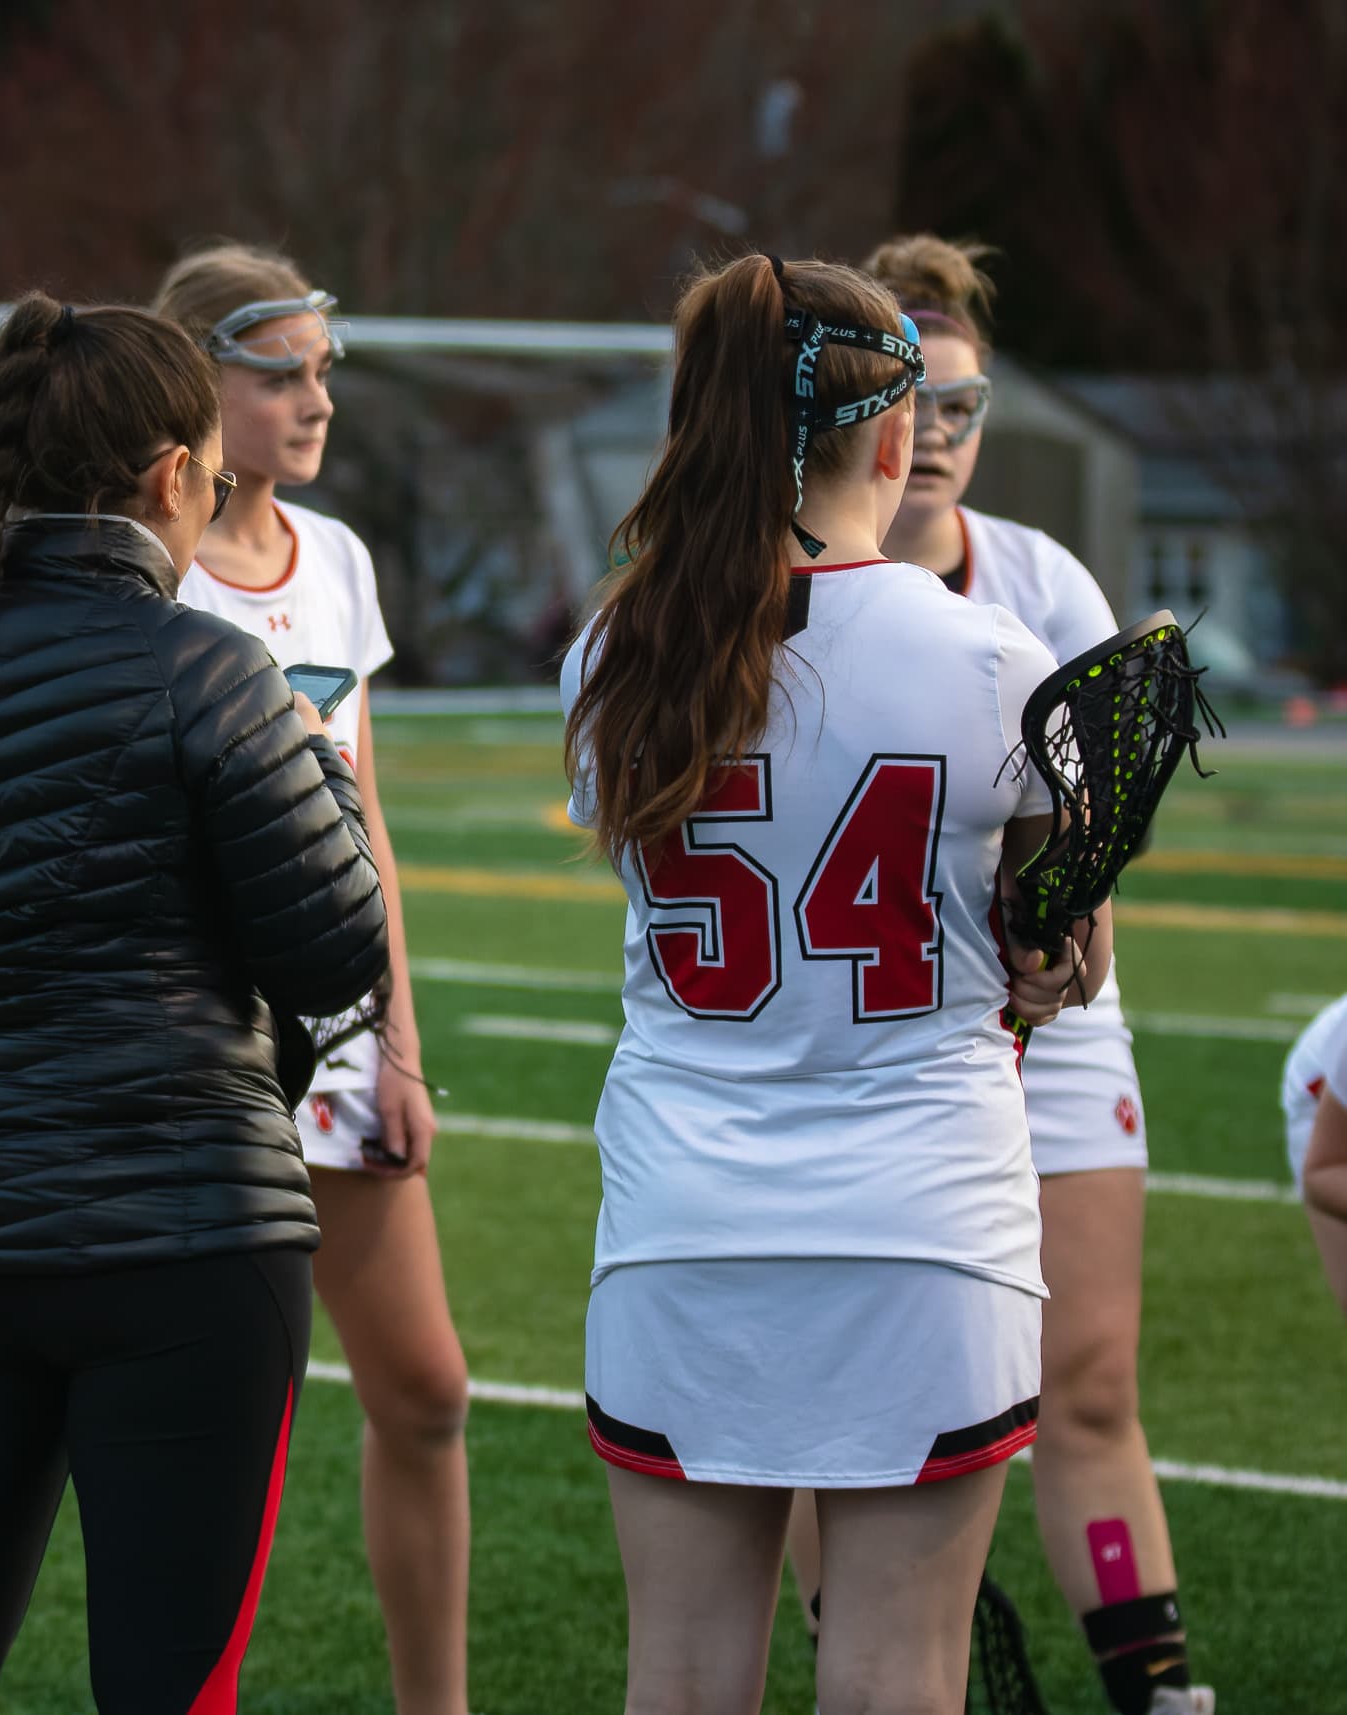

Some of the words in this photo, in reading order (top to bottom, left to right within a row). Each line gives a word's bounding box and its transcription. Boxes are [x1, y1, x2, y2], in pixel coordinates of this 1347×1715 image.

[823, 325, 858, 339] PLUS
[881, 332, 916, 364] STX
[795, 341, 822, 399] STX
[834, 389, 891, 426] STX
[796, 425, 808, 457] PLUS
[637, 752, 947, 1024] 54
